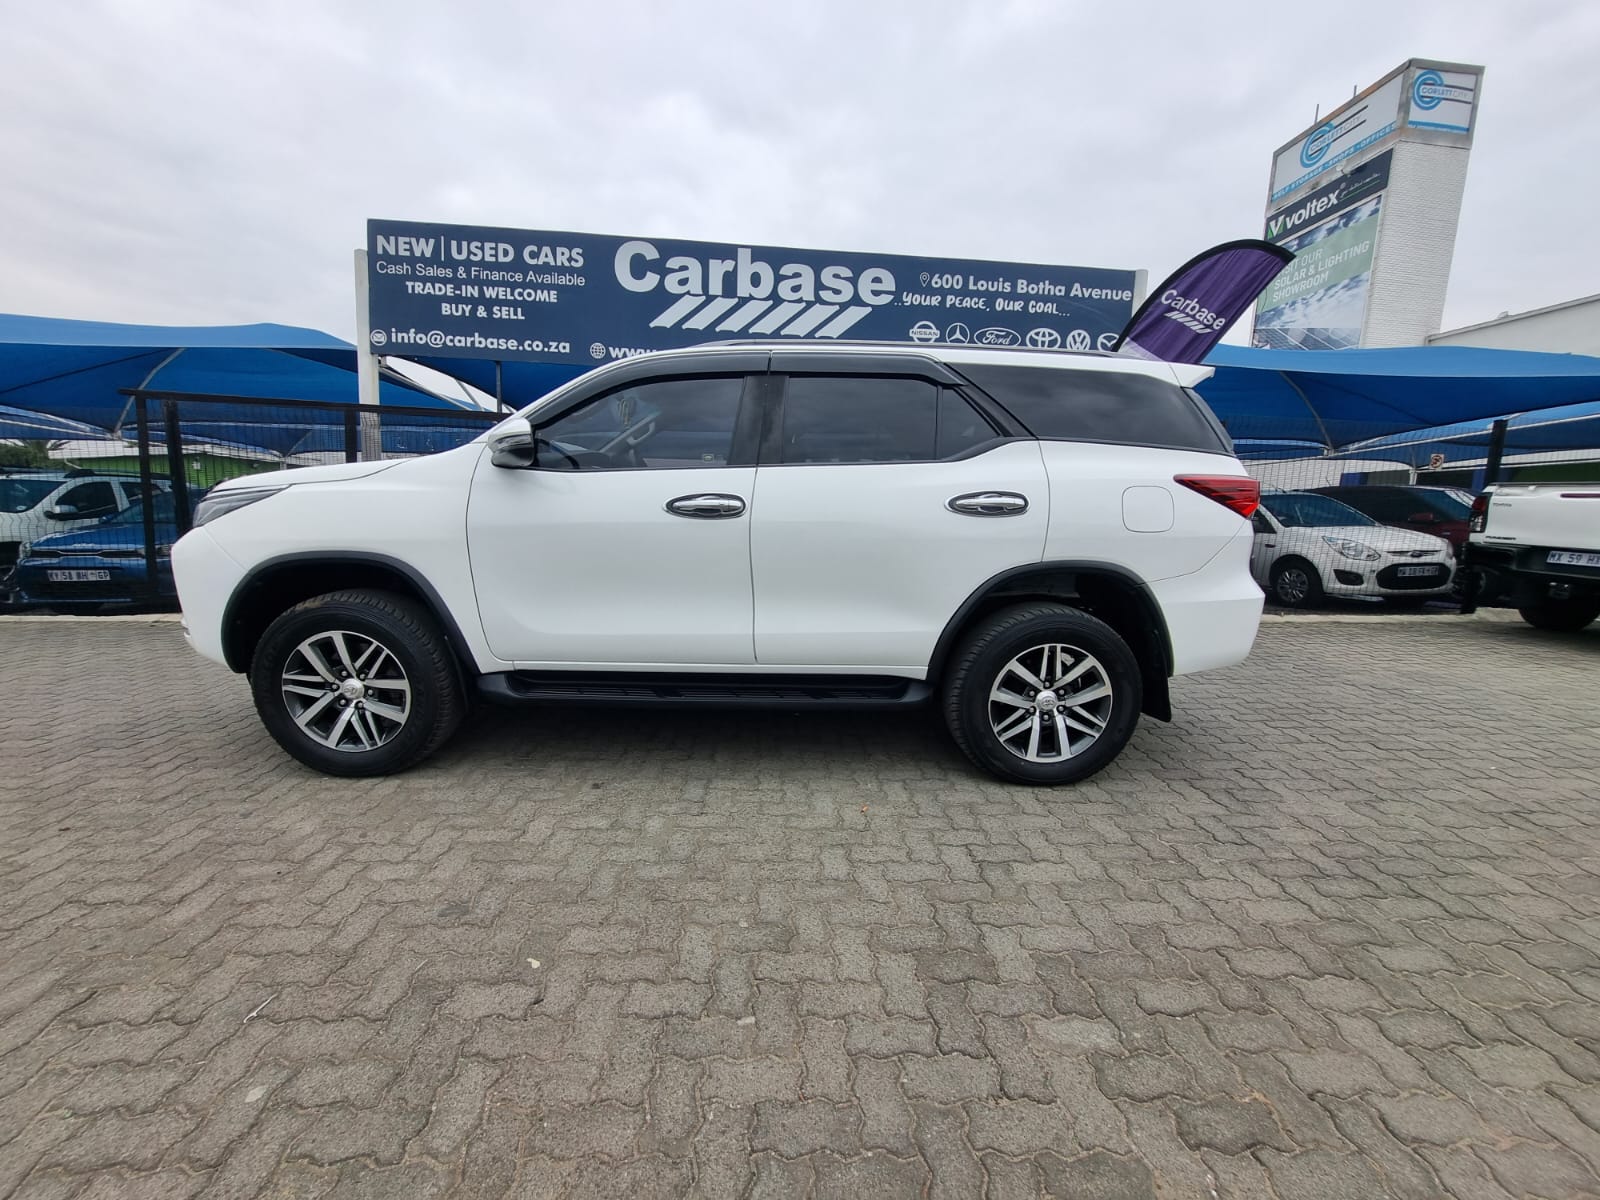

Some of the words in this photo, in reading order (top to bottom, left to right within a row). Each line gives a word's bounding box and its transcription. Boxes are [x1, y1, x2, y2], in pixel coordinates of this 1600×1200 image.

[1286, 189, 1341, 229] voltex
[376, 234, 435, 258] NEW
[450, 240, 515, 263] USED
[522, 245, 585, 268] CARS
[1301, 248, 1323, 266] OUR
[376, 261, 412, 276] Cash
[415, 263, 453, 278] Sales
[457, 266, 467, 279] &
[471, 267, 523, 282] Finance
[526, 271, 586, 286] Available
[614, 240, 896, 306] Carbase
[1274, 268, 1306, 290] SOLAR
[1318, 241, 1370, 271] LIGHTING
[406, 281, 479, 298] TRADE-IN
[483, 286, 558, 303] WELCOME
[931, 273, 963, 290] 600
[968, 275, 1012, 293] Louis
[1016, 278, 1066, 297] Botha
[1070, 283, 1132, 302] Avenue
[1272, 271, 1329, 302] SHOWROOM
[441, 303, 473, 317] BUY
[476, 305, 488, 318] &
[492, 306, 525, 320] SELL
[995, 298, 1024, 312] OUR
[1161, 289, 1226, 331] Carbase
[391, 328, 570, 353] info@carbase.co.za
[911, 329, 939, 338] NISSAN
[982, 329, 1012, 346] Ford
